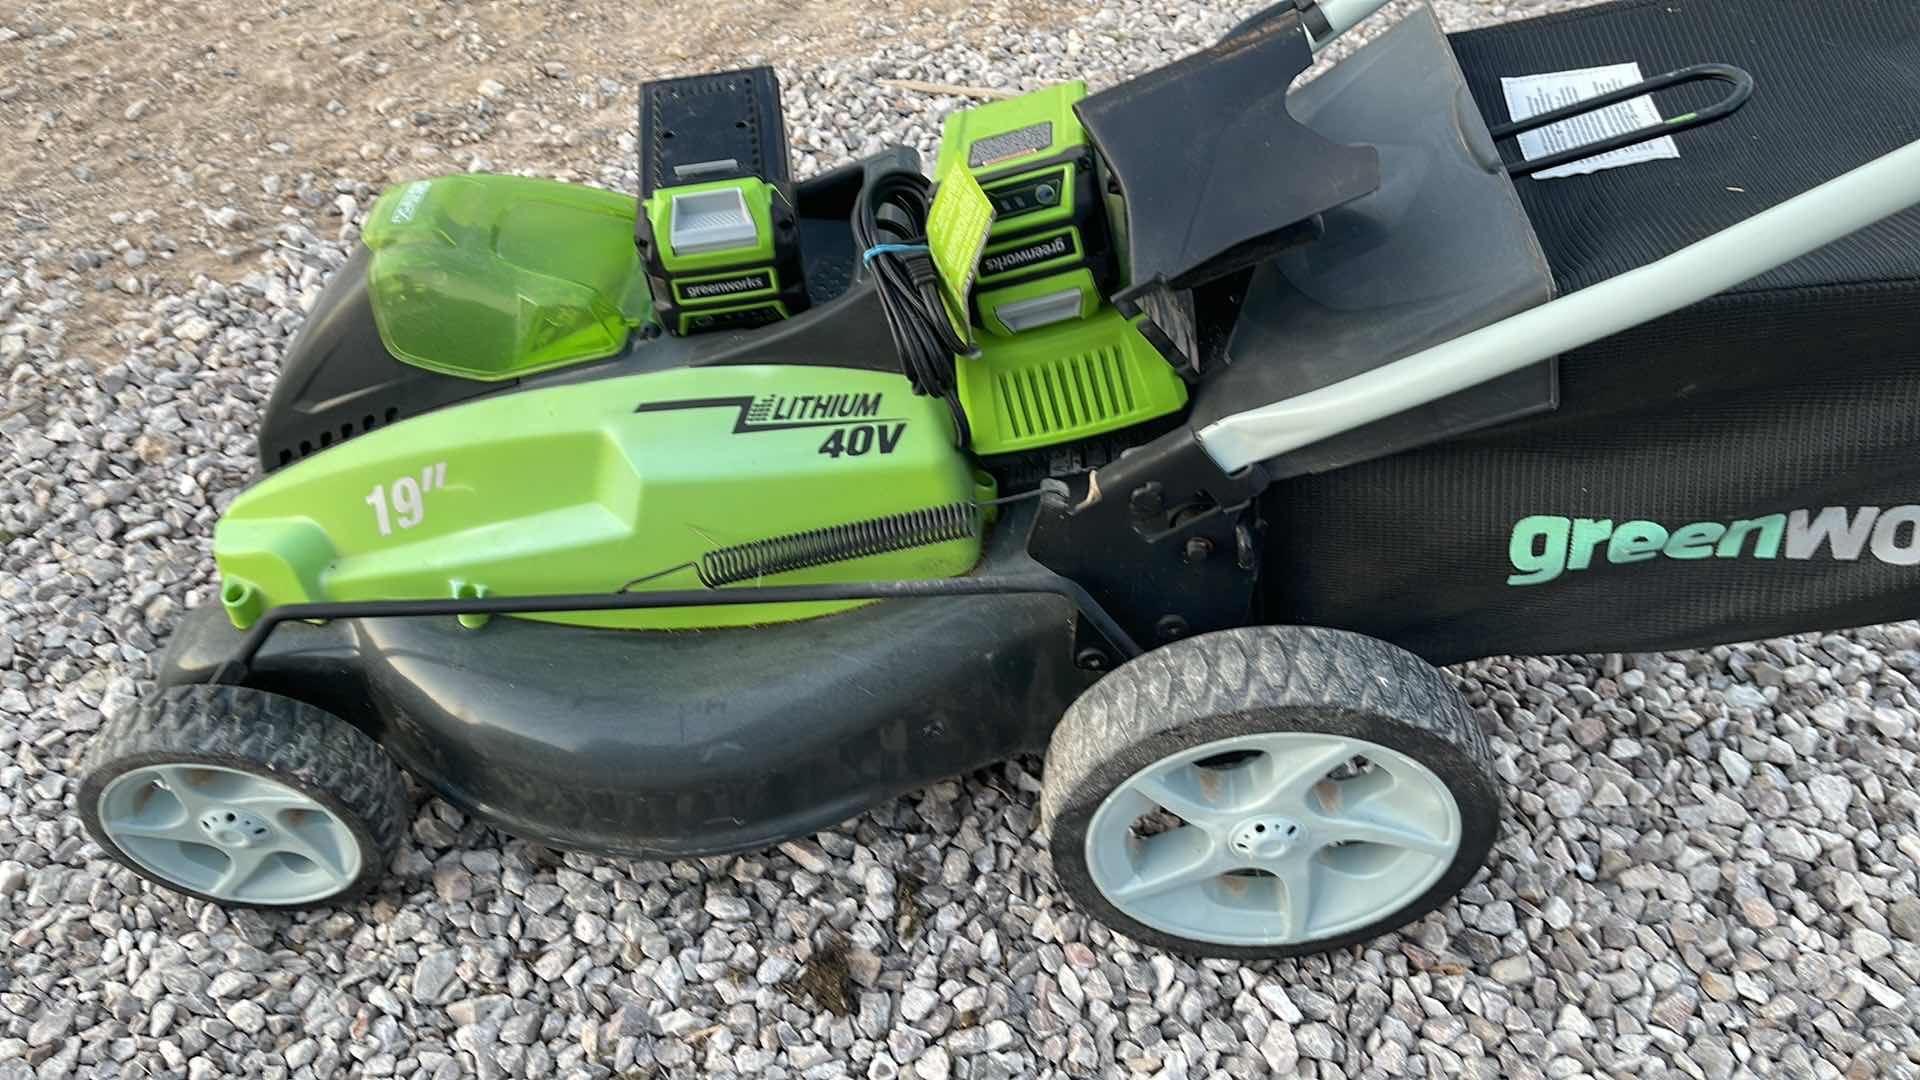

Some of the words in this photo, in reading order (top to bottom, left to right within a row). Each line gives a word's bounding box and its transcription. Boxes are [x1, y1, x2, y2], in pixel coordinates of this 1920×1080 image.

[985, 237, 1066, 272] greenworks
[686, 274, 764, 297] greenworks
[772, 392, 882, 420] LITHIUM
[819, 423, 906, 459] 40V
[365, 462, 448, 537] 19"
